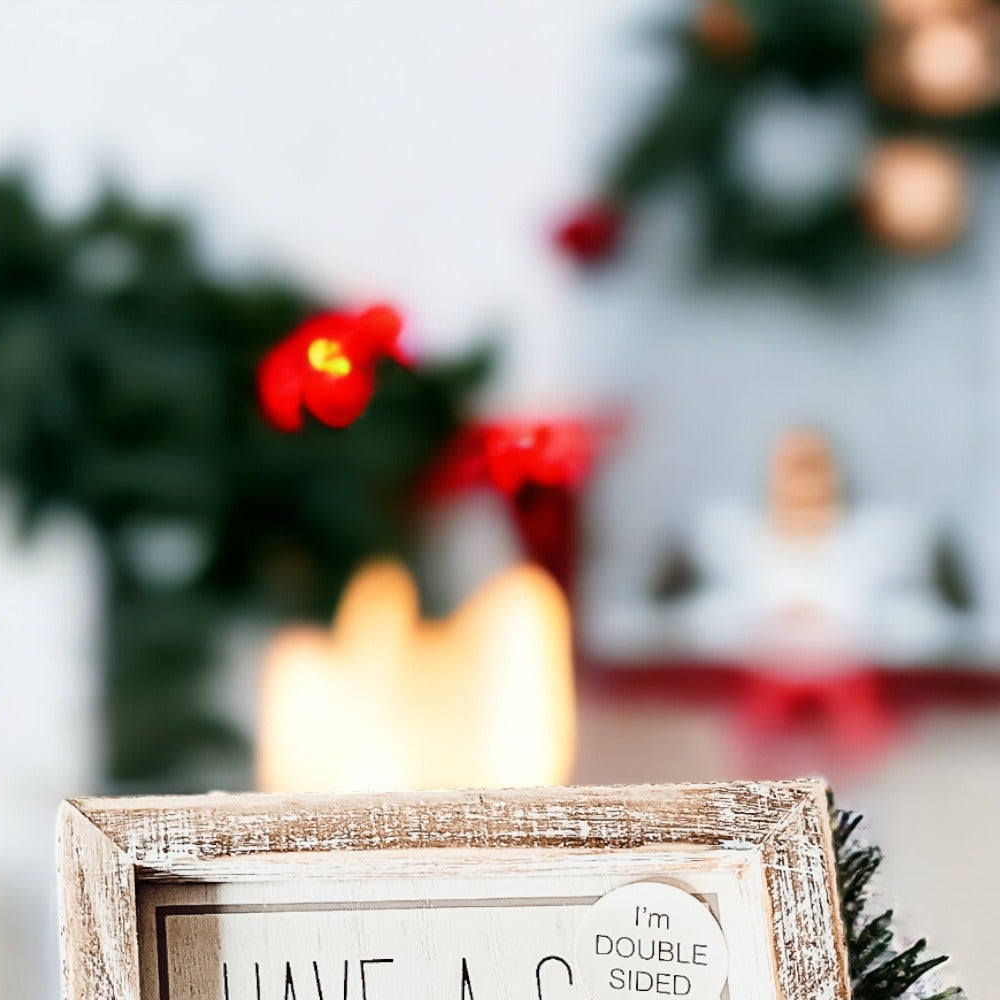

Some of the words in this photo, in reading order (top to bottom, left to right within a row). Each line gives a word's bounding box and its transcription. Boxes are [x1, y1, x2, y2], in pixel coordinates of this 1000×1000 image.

[633, 906, 671, 930] I'm
[594, 933, 709, 967] DOUBLE
[608, 968, 692, 997] SIDED
